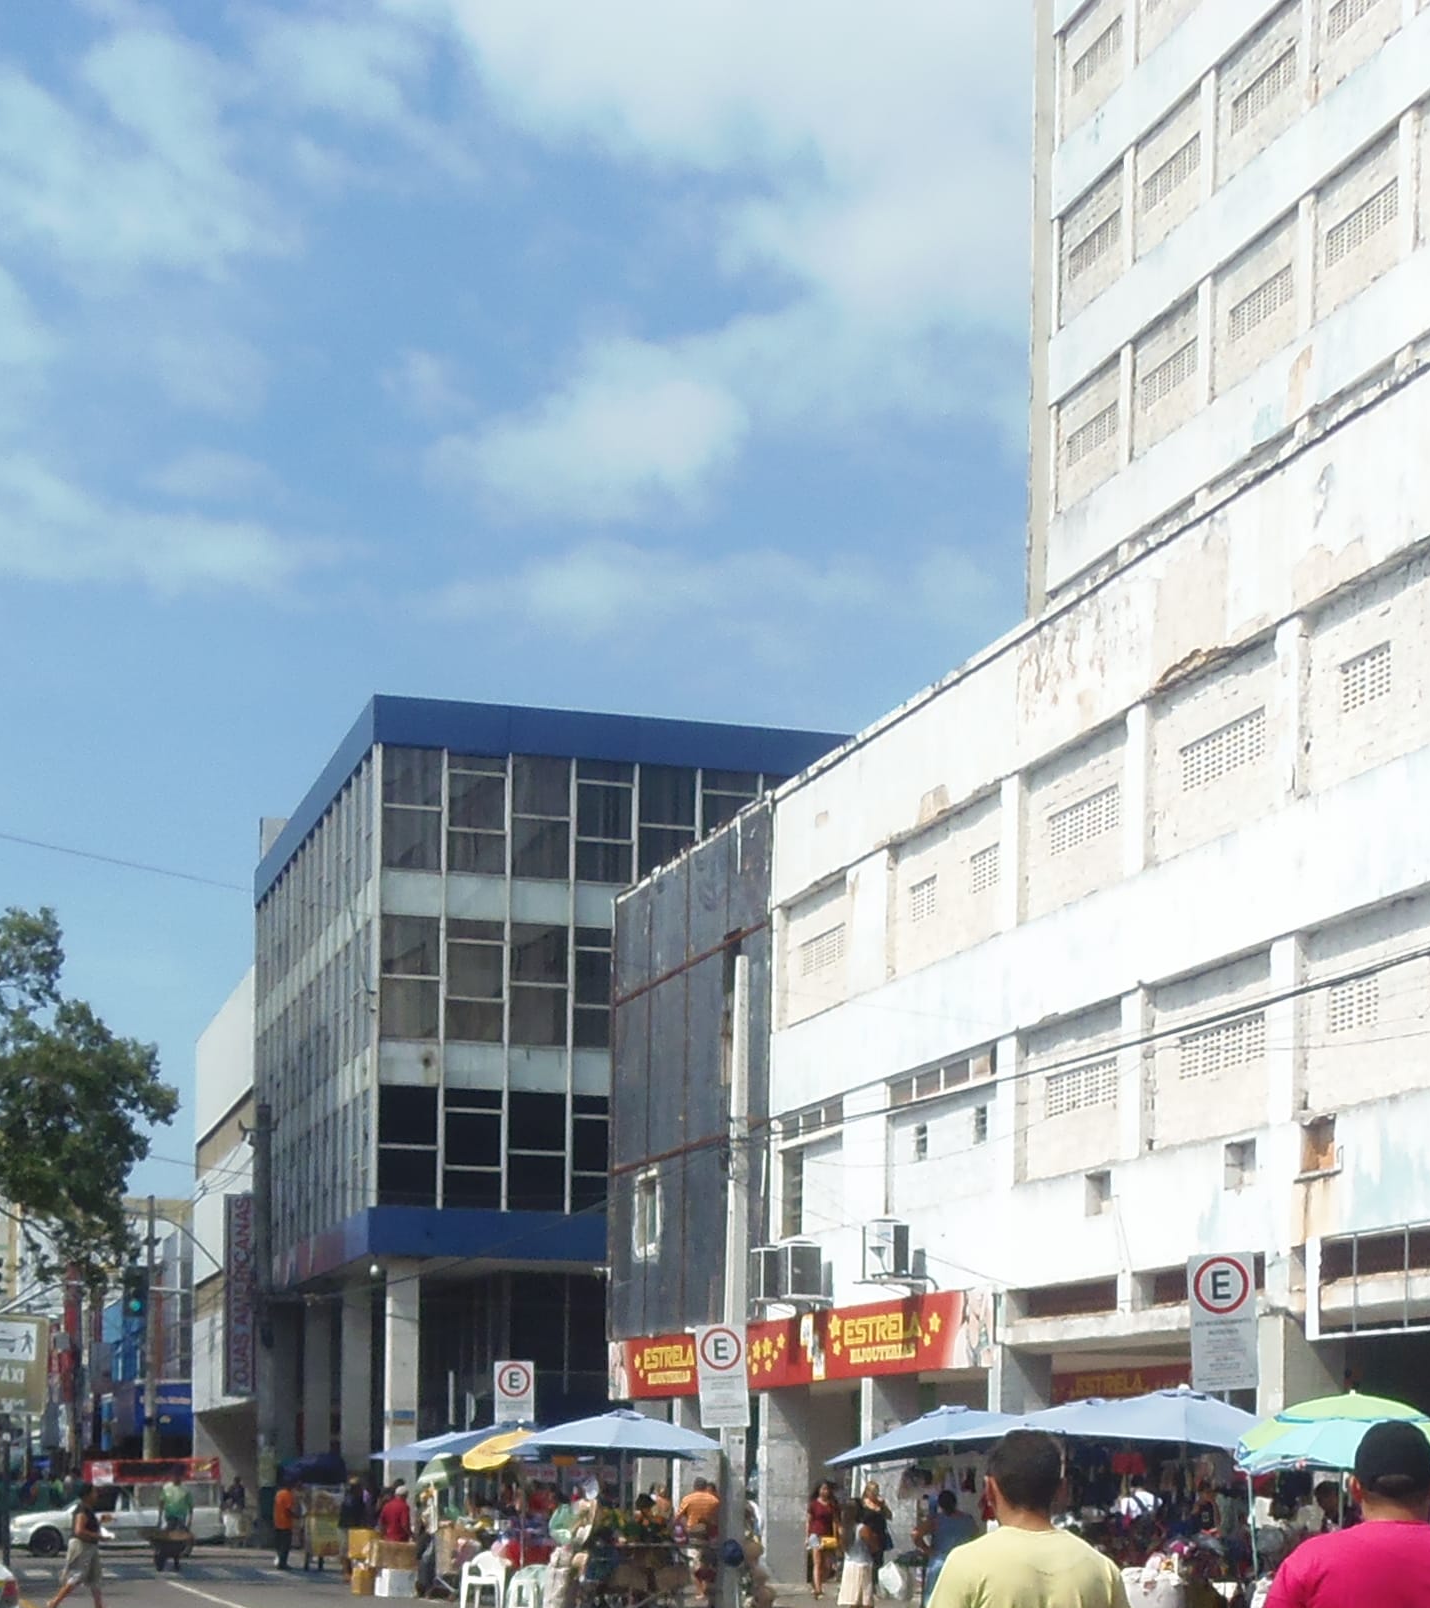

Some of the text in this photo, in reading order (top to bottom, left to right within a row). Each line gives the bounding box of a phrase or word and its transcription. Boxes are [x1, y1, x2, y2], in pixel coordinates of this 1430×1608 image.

[1211, 1269, 1232, 1300] E
[843, 1311, 923, 1347] ESTRELA
[643, 1344, 695, 1370] ESTRELA
[713, 1337, 729, 1361] E
[508, 1371, 520, 1390] E
